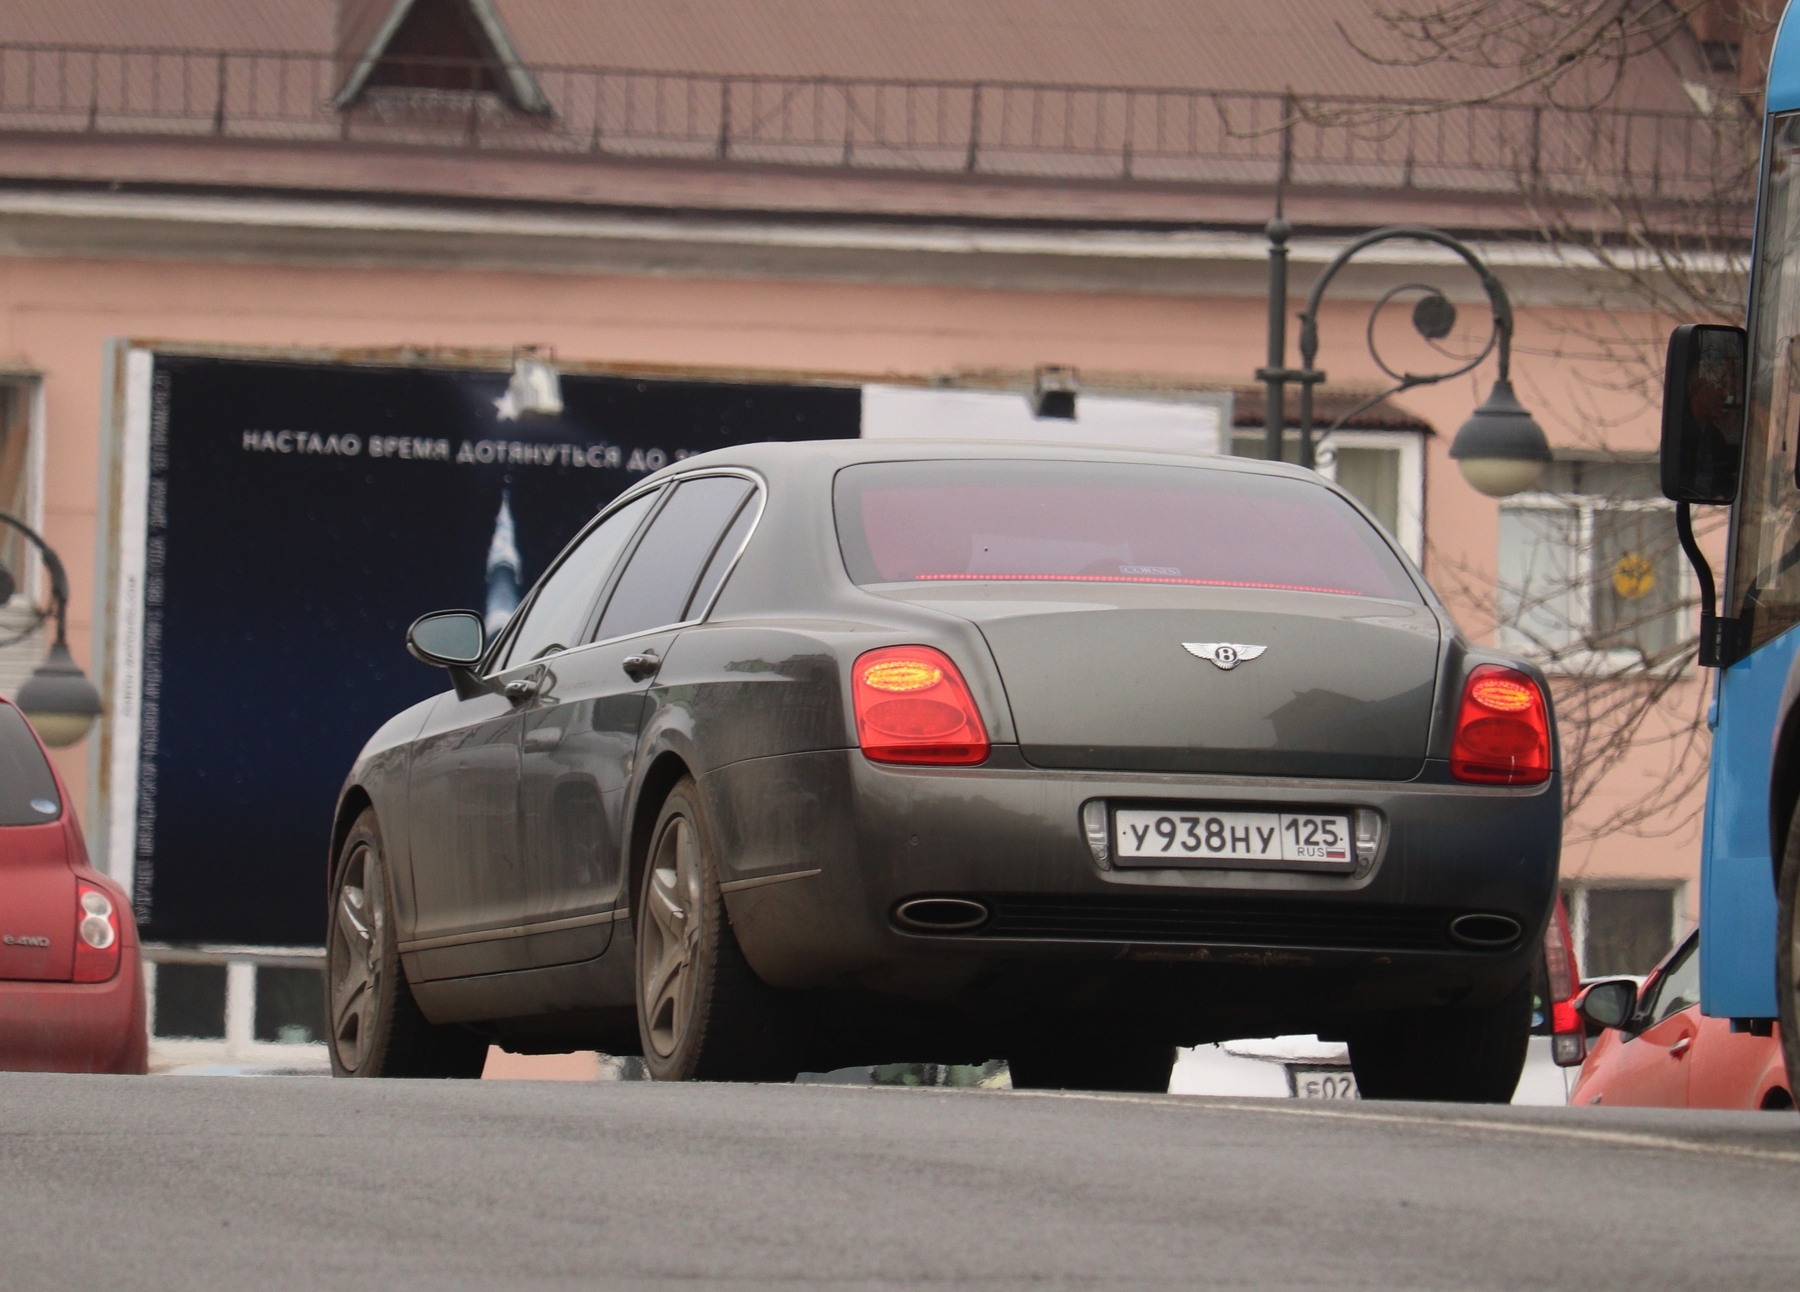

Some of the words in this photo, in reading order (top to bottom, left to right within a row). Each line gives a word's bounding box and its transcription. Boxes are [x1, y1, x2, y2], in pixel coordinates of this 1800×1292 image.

[242, 428, 361, 456] НАСТАЛО
[368, 434, 449, 460] ВРЕМЯ
[456, 439, 621, 469] ДОТЯНУТЬСЯ
[626, 447, 668, 473] ДО
[1130, 816, 1275, 854] У938НУ
[1285, 818, 1338, 847] 125
[1297, 847, 1326, 858] RUS
